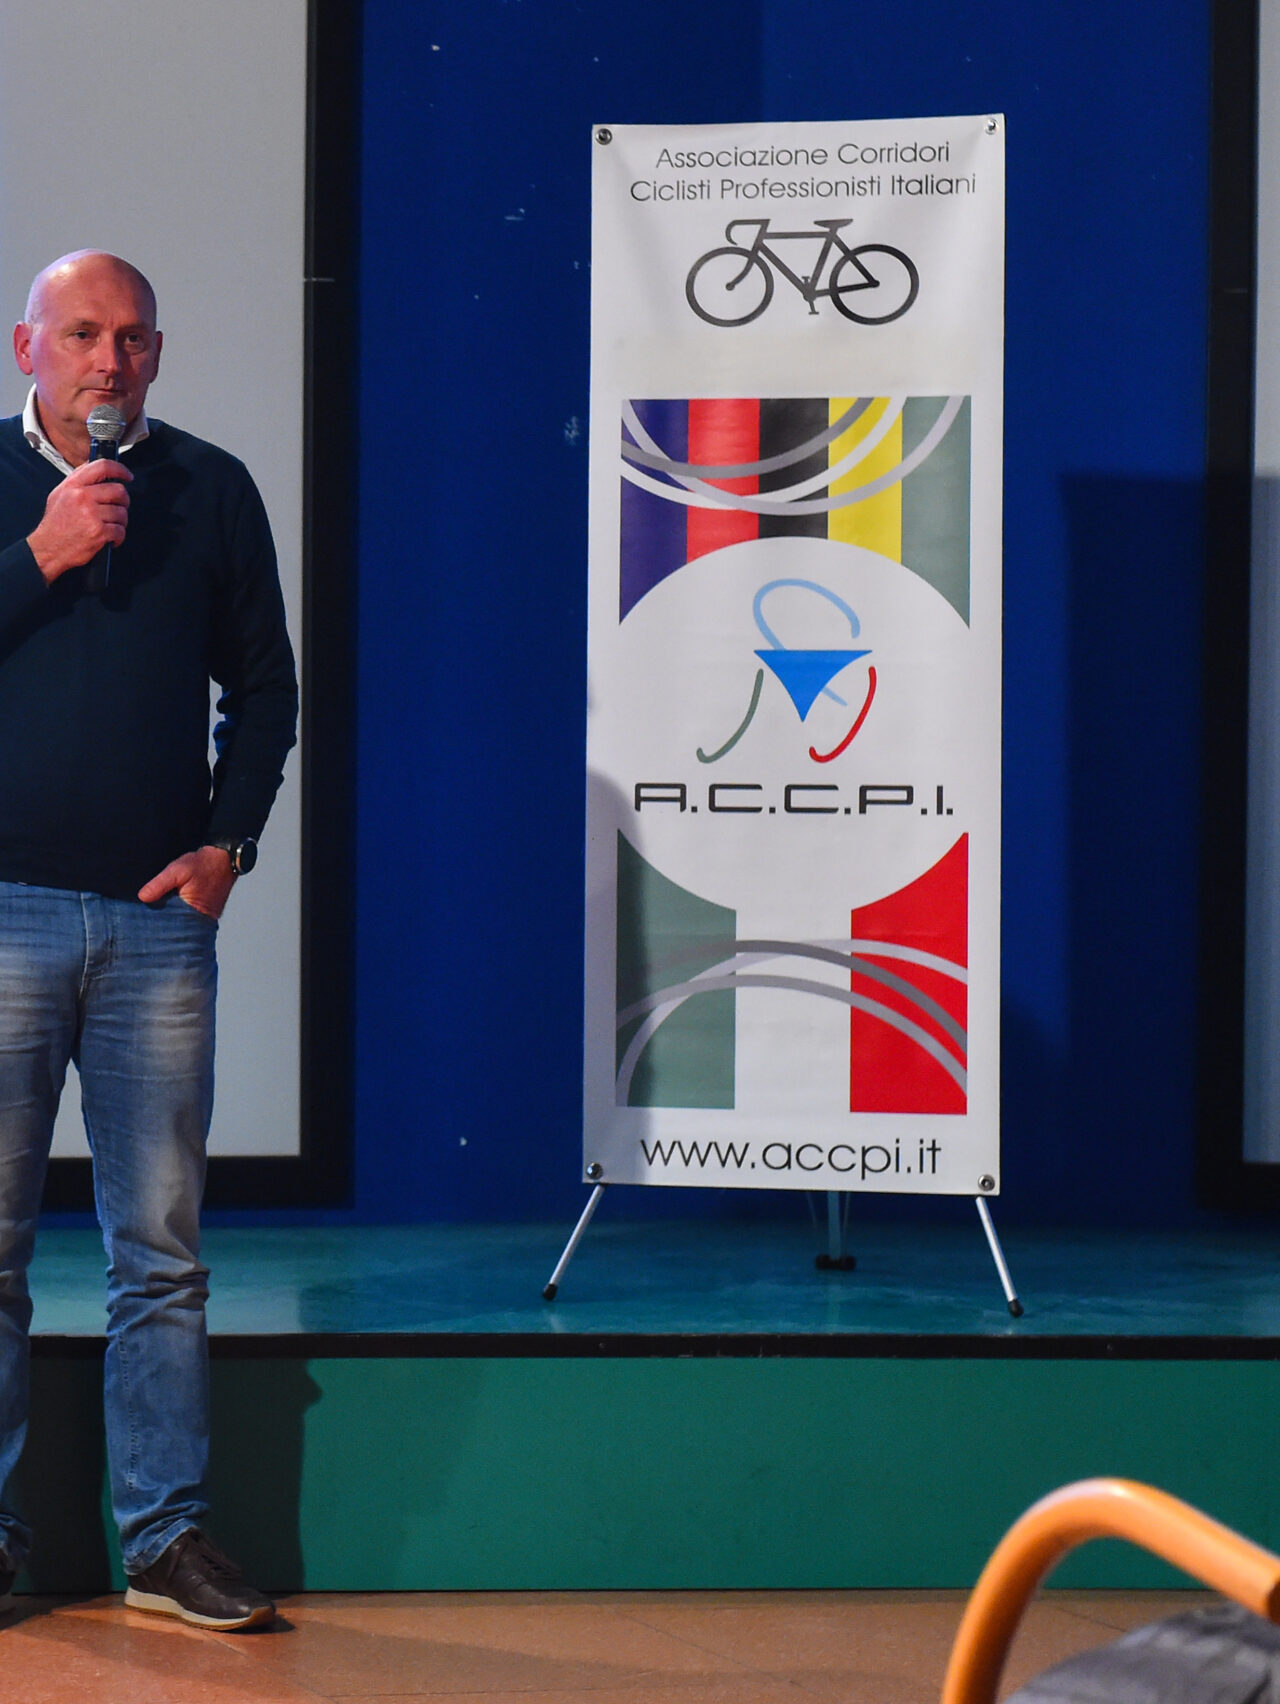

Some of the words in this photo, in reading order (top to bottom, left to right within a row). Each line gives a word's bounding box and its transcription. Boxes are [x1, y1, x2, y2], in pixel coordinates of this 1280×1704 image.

[655, 145, 829, 169] Associazione
[837, 141, 950, 164] Corridori
[630, 179, 711, 202] Ciclisti
[720, 176, 881, 199] Professionisti
[891, 173, 977, 195] Italiani
[634, 783, 954, 816] A.C.C.P.I.
[640, 1137, 942, 1180] www.accpi.it
